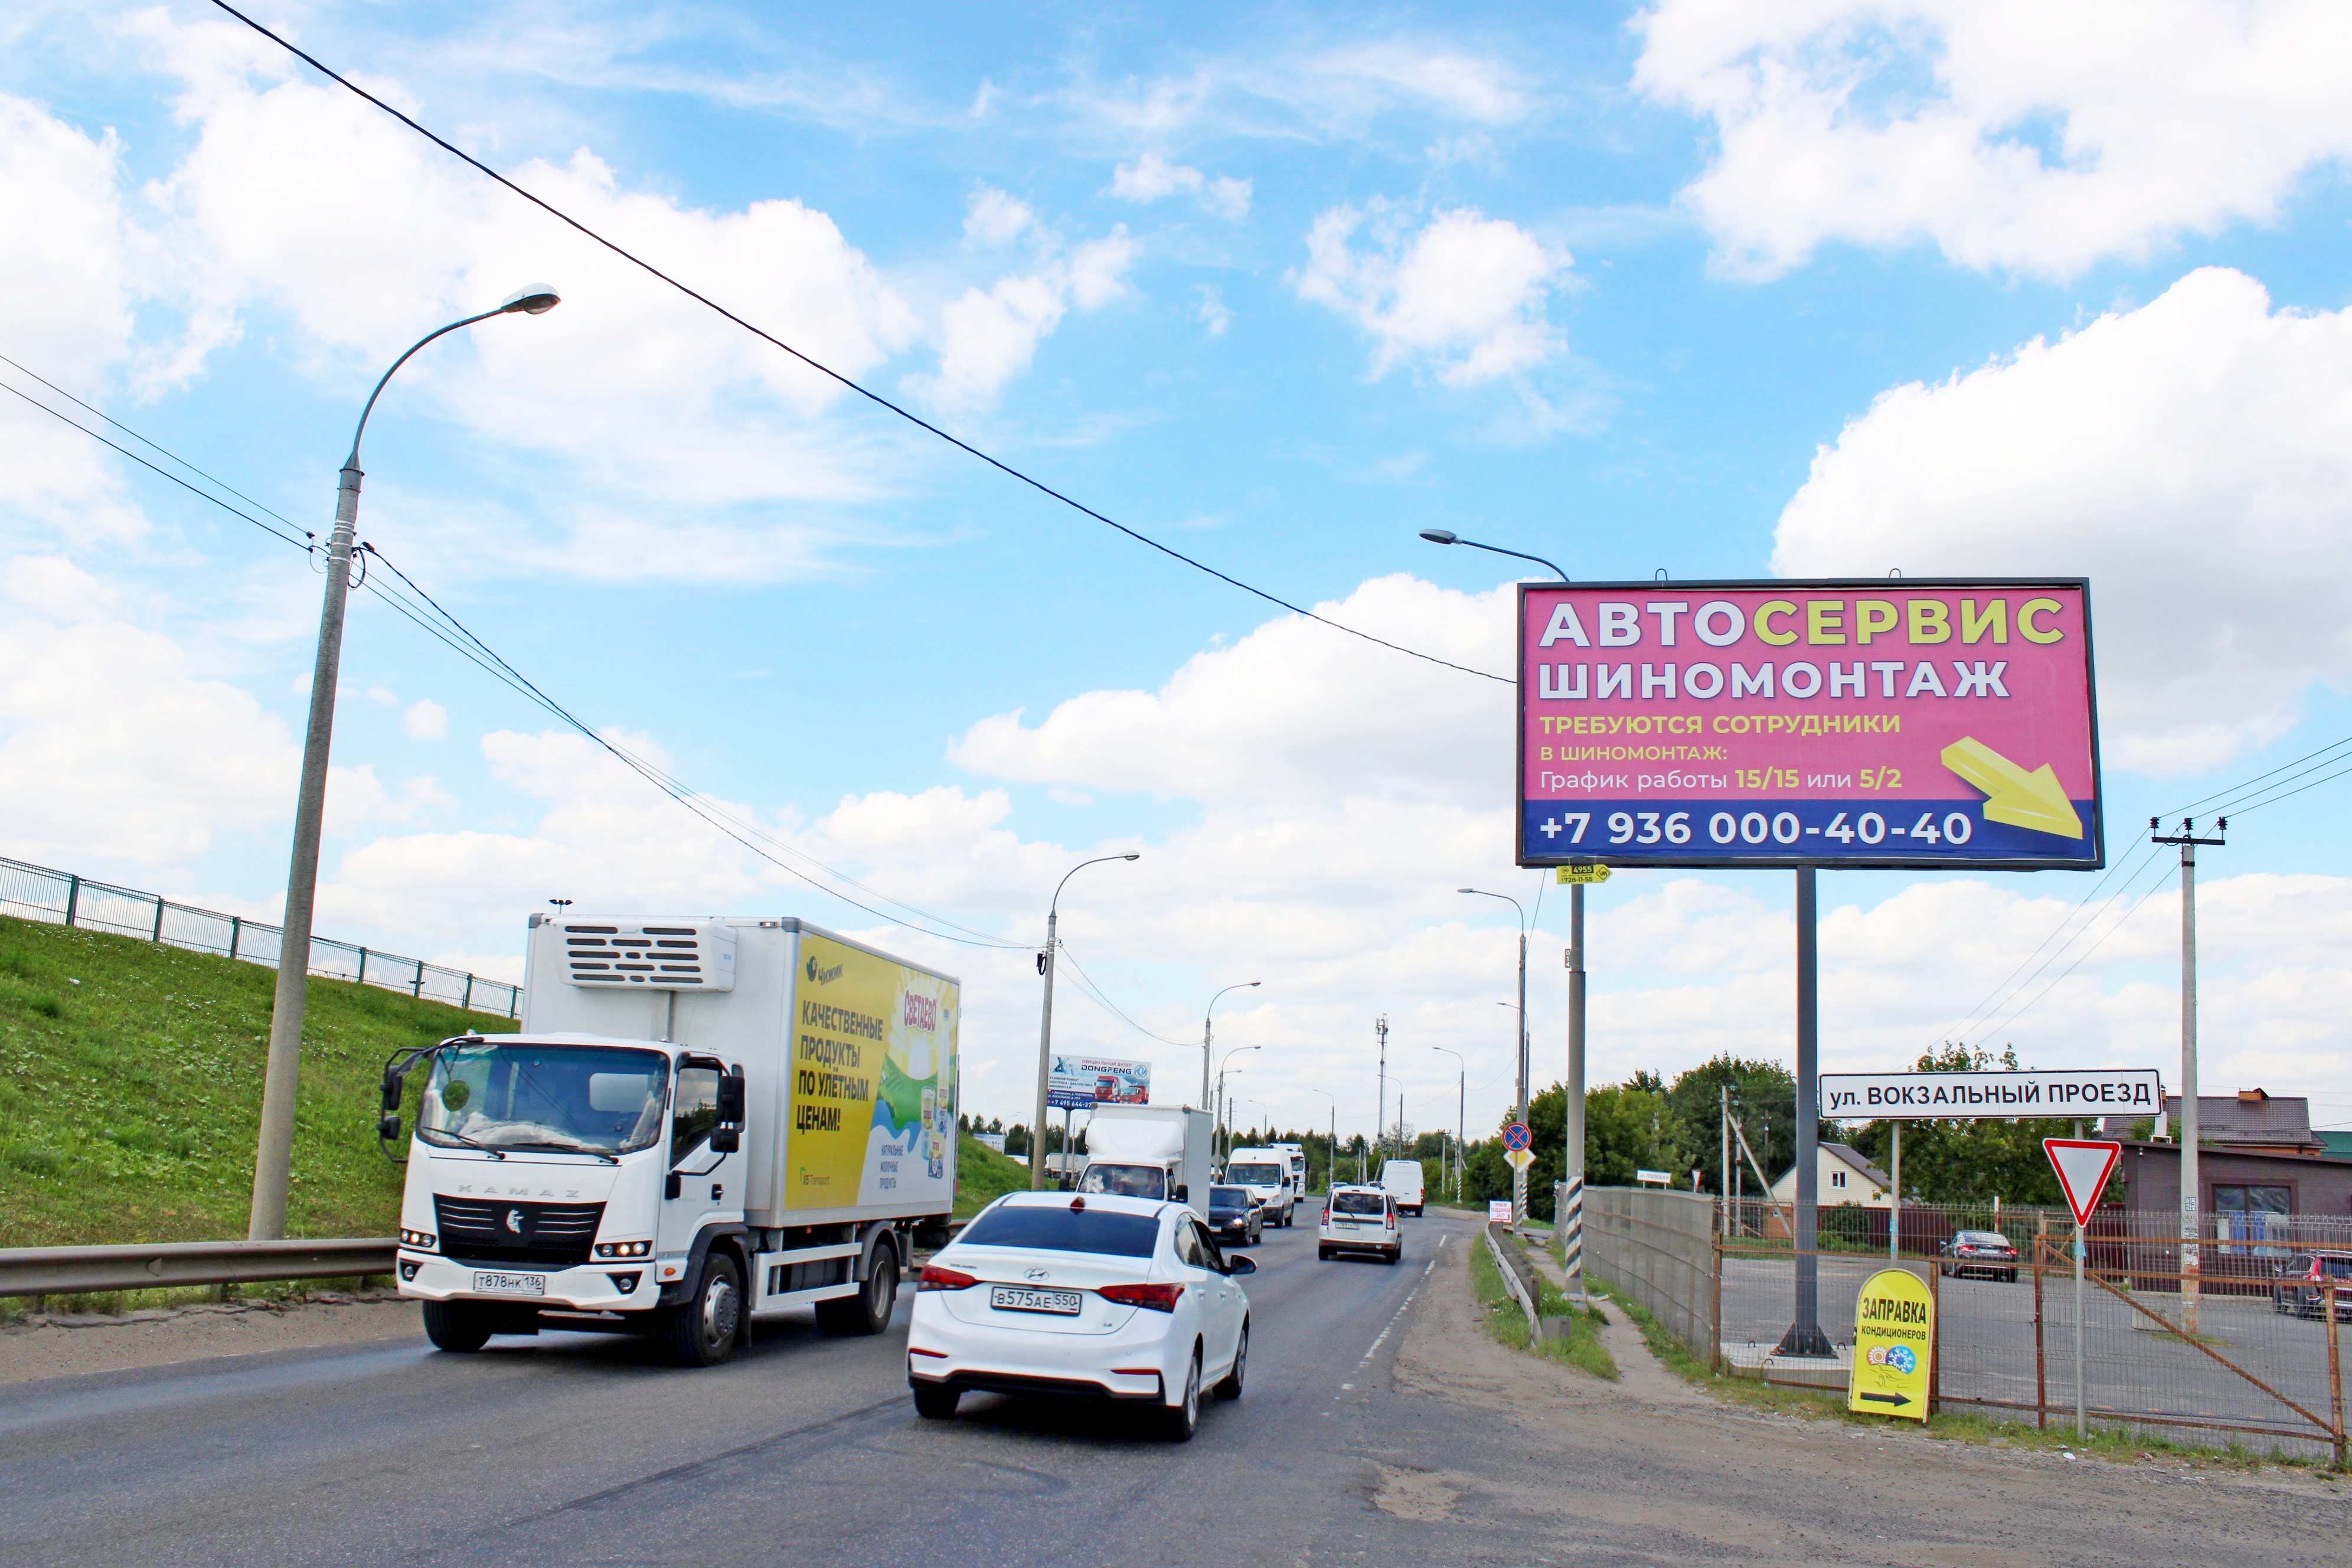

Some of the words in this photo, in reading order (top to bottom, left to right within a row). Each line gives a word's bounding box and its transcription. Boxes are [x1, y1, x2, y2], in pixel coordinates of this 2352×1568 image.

[1538, 597, 2065, 648] АВТОСЕРВИС
[1538, 660, 2010, 700] ШИНОМОНТАЖ
[1540, 716, 1703, 734] ТРЕБУЮТСЯ
[1712, 715, 1902, 737] СОТРУДНИКИ
[1540, 747, 1553, 760] В
[1561, 746, 1727, 760] ШИНОМОНТАЖ:
[1540, 770, 1629, 791] График
[1638, 769, 1727, 792] работы
[1734, 768, 1799, 791] 15/15
[1807, 773, 1851, 789] или
[1860, 768, 1903, 791] 5/2
[1540, 813, 1590, 844] +7
[1608, 813, 1691, 845] 936
[1709, 812, 1972, 845] 000-40-40
[802, 999, 884, 1041] КАЧЕСТВЕННЫЕ
[904, 989, 936, 1032] СВЕТАЕВО
[800, 1034, 860, 1069] ПРОДУКТЫ
[1081, 1065, 1132, 1074] DONGFENG
[798, 1069, 815, 1096] ПО
[818, 1067, 869, 1102] УЛЁТНЫМ
[1830, 1091, 1861, 1109] ул.
[1867, 1081, 2040, 1105] ВОКЗАЛЬНЫЙ
[2049, 1083, 2151, 1106] ПРОЕЗД
[796, 1104, 841, 1135] ЦЕНАМ!
[458, 1184, 579, 1198] KAMAZ
[1862, 1297, 1926, 1324] ЗАПРАВКА
[1861, 1325, 1926, 1340] КОНДИЦИОНЕРОВ
